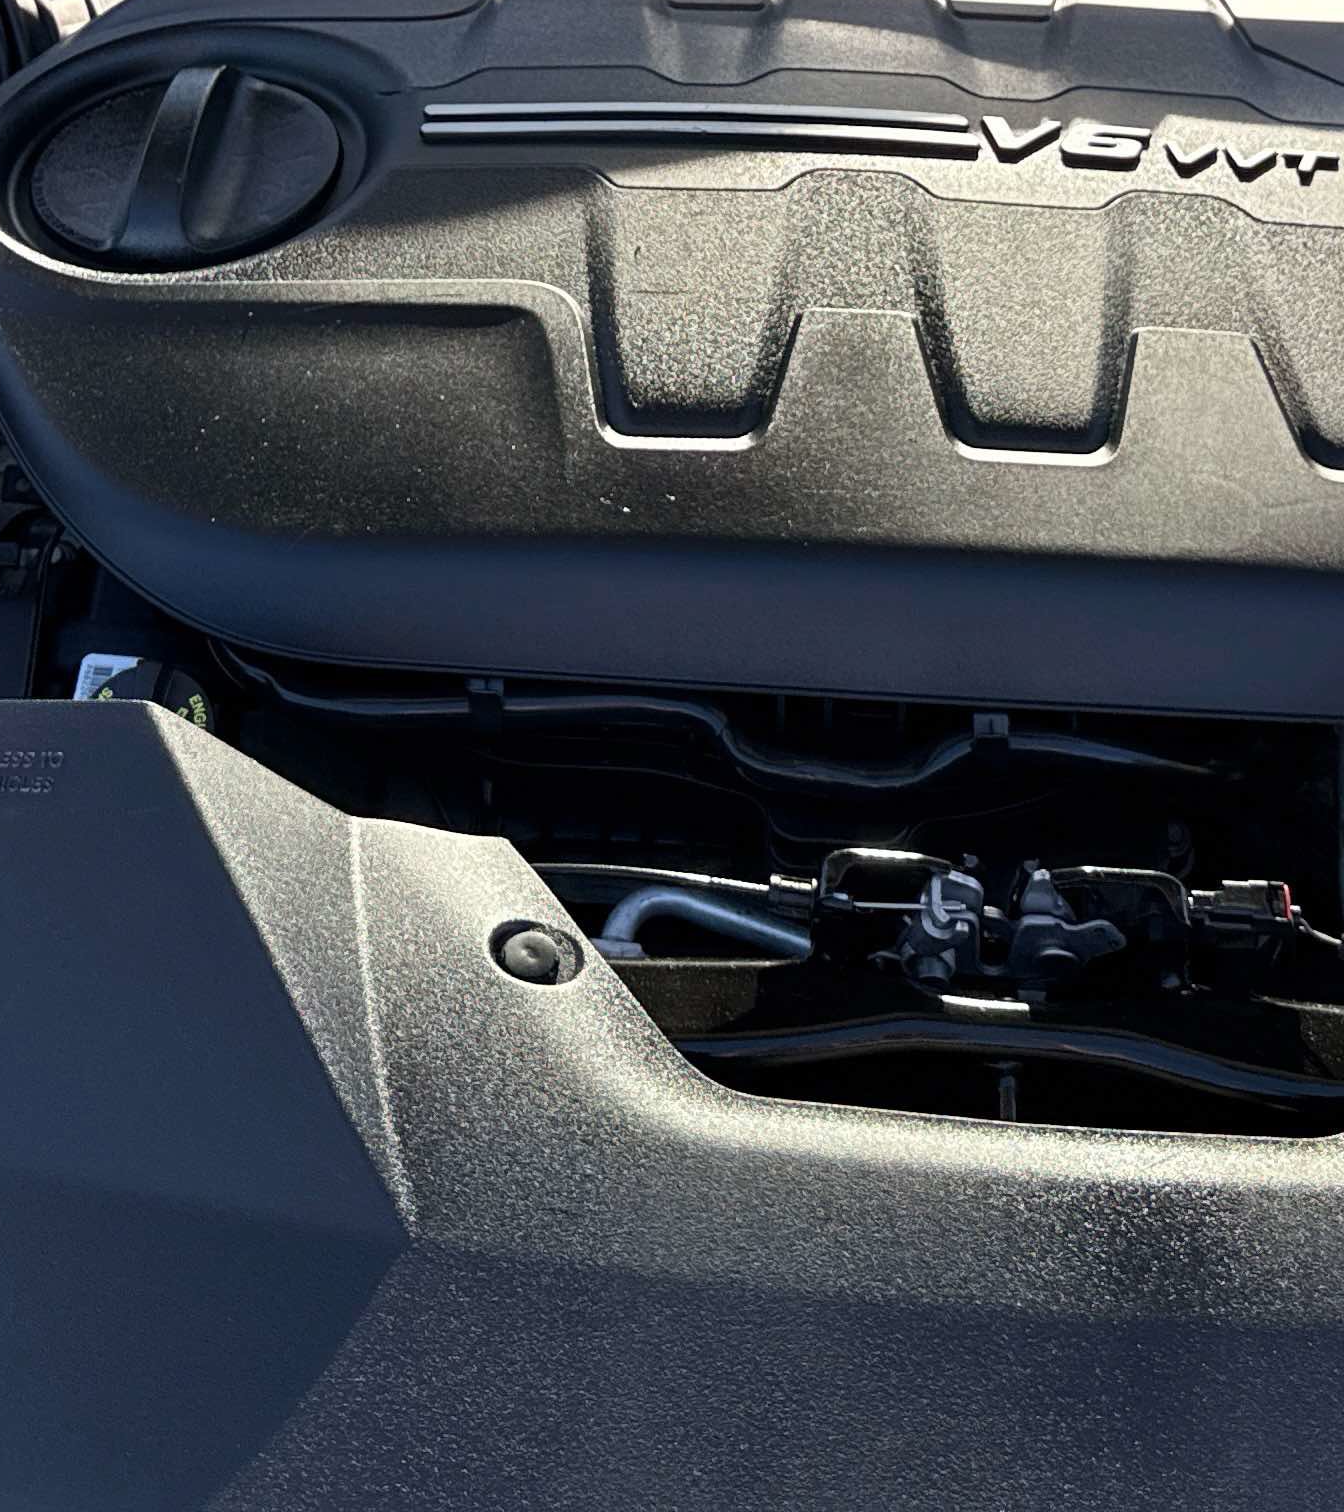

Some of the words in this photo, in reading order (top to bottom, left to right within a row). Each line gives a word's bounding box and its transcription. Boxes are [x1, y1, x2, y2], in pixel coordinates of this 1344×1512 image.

[981, 115, 1151, 171] V6
[1164, 143, 1340, 186] VVT
[38, 750, 65, 768] TO
